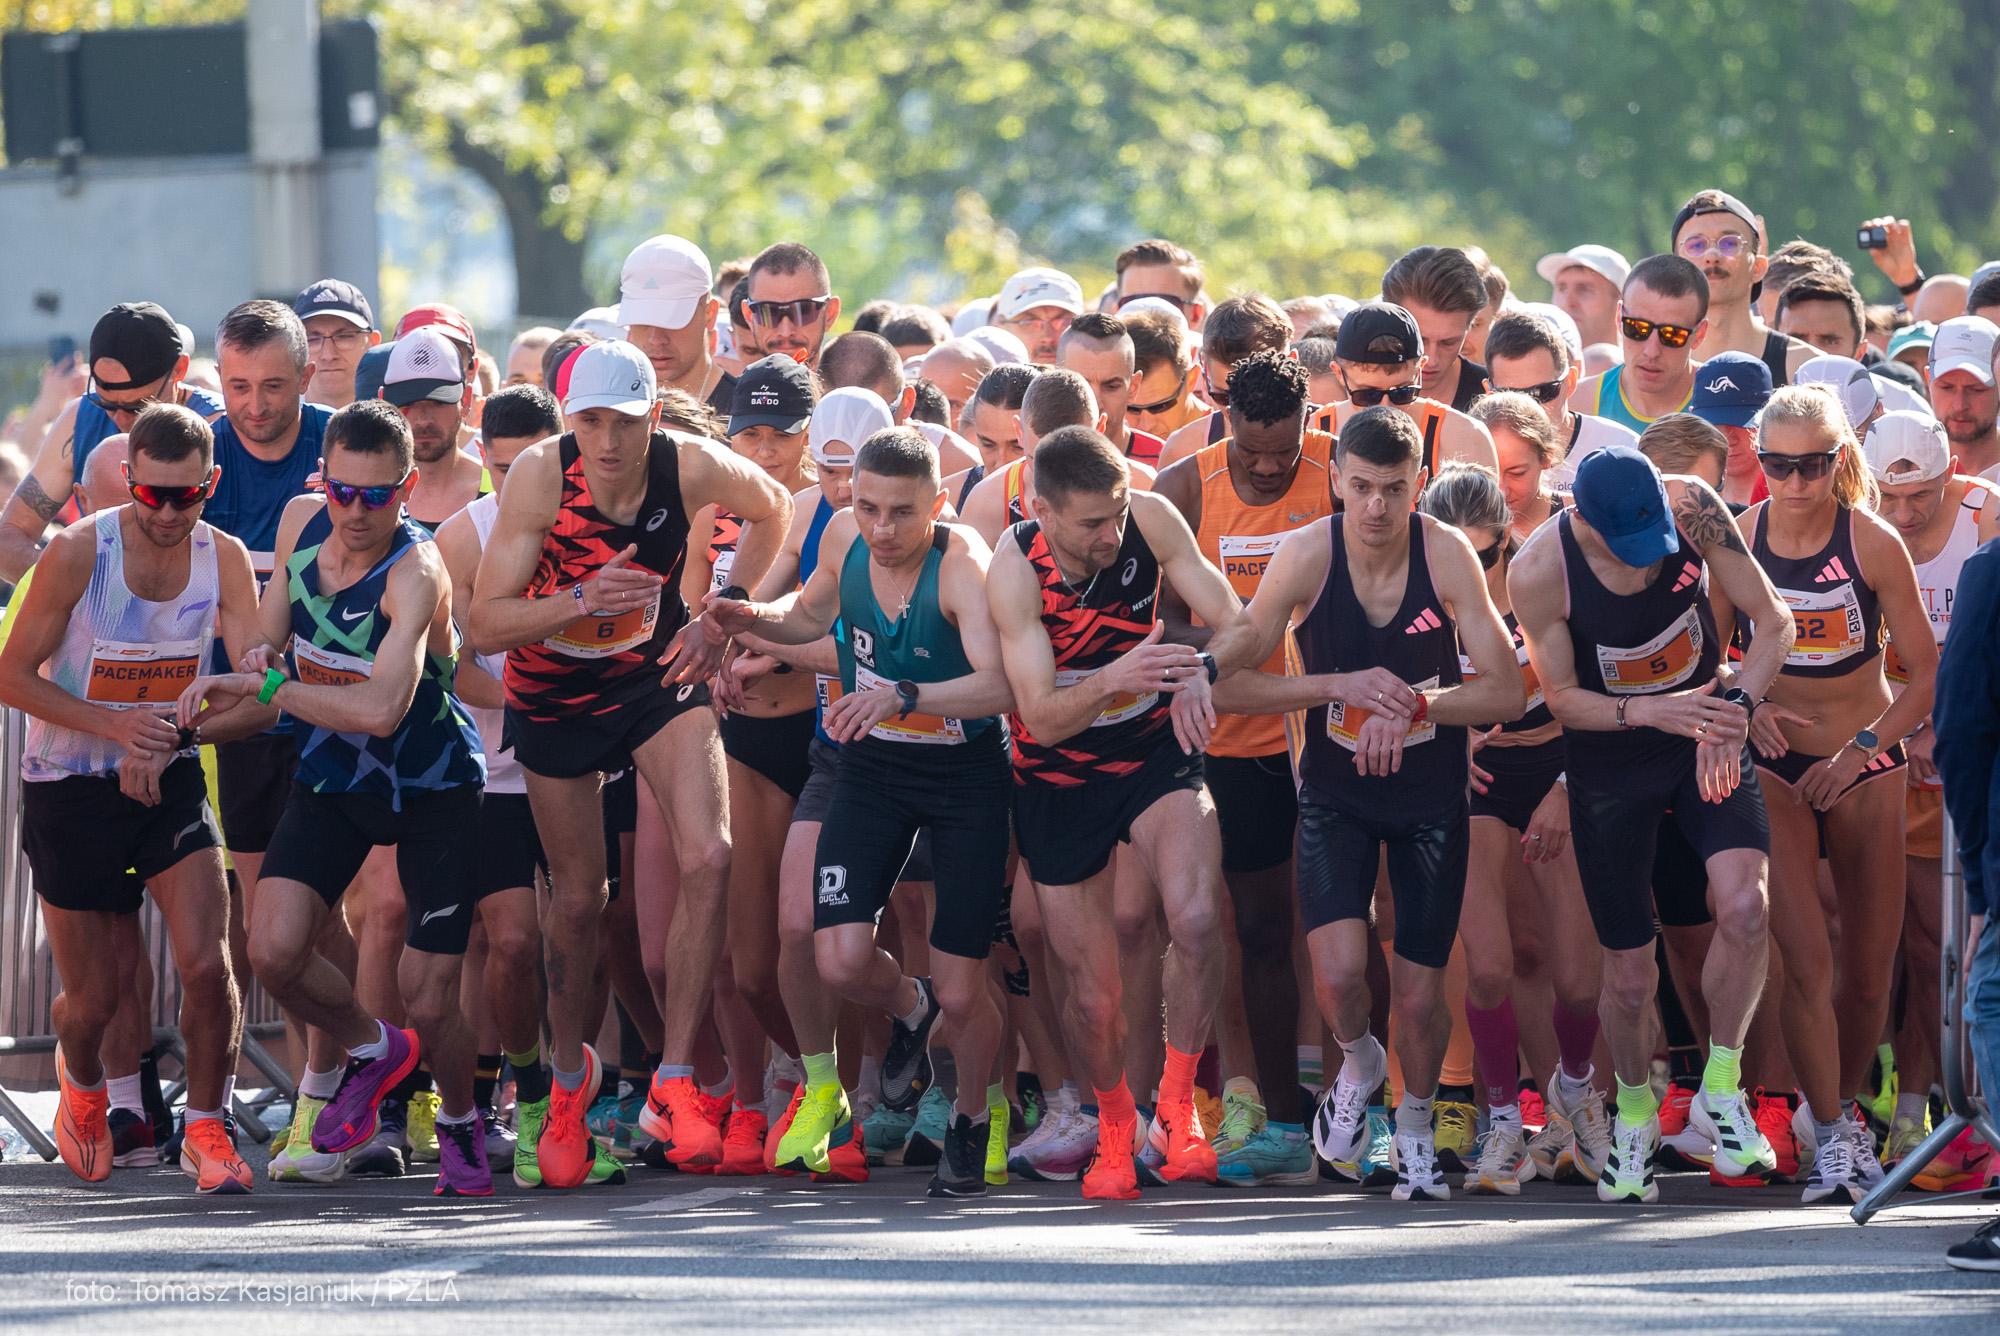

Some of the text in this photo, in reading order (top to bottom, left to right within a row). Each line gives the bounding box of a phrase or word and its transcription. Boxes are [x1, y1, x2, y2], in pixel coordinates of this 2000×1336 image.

[598, 622, 615, 638] 6
[93, 664, 197, 681] PACEMAKER
[1650, 656, 1668, 674] 5
[299, 662, 357, 687] PACEMA
[137, 686, 148, 699] 2
